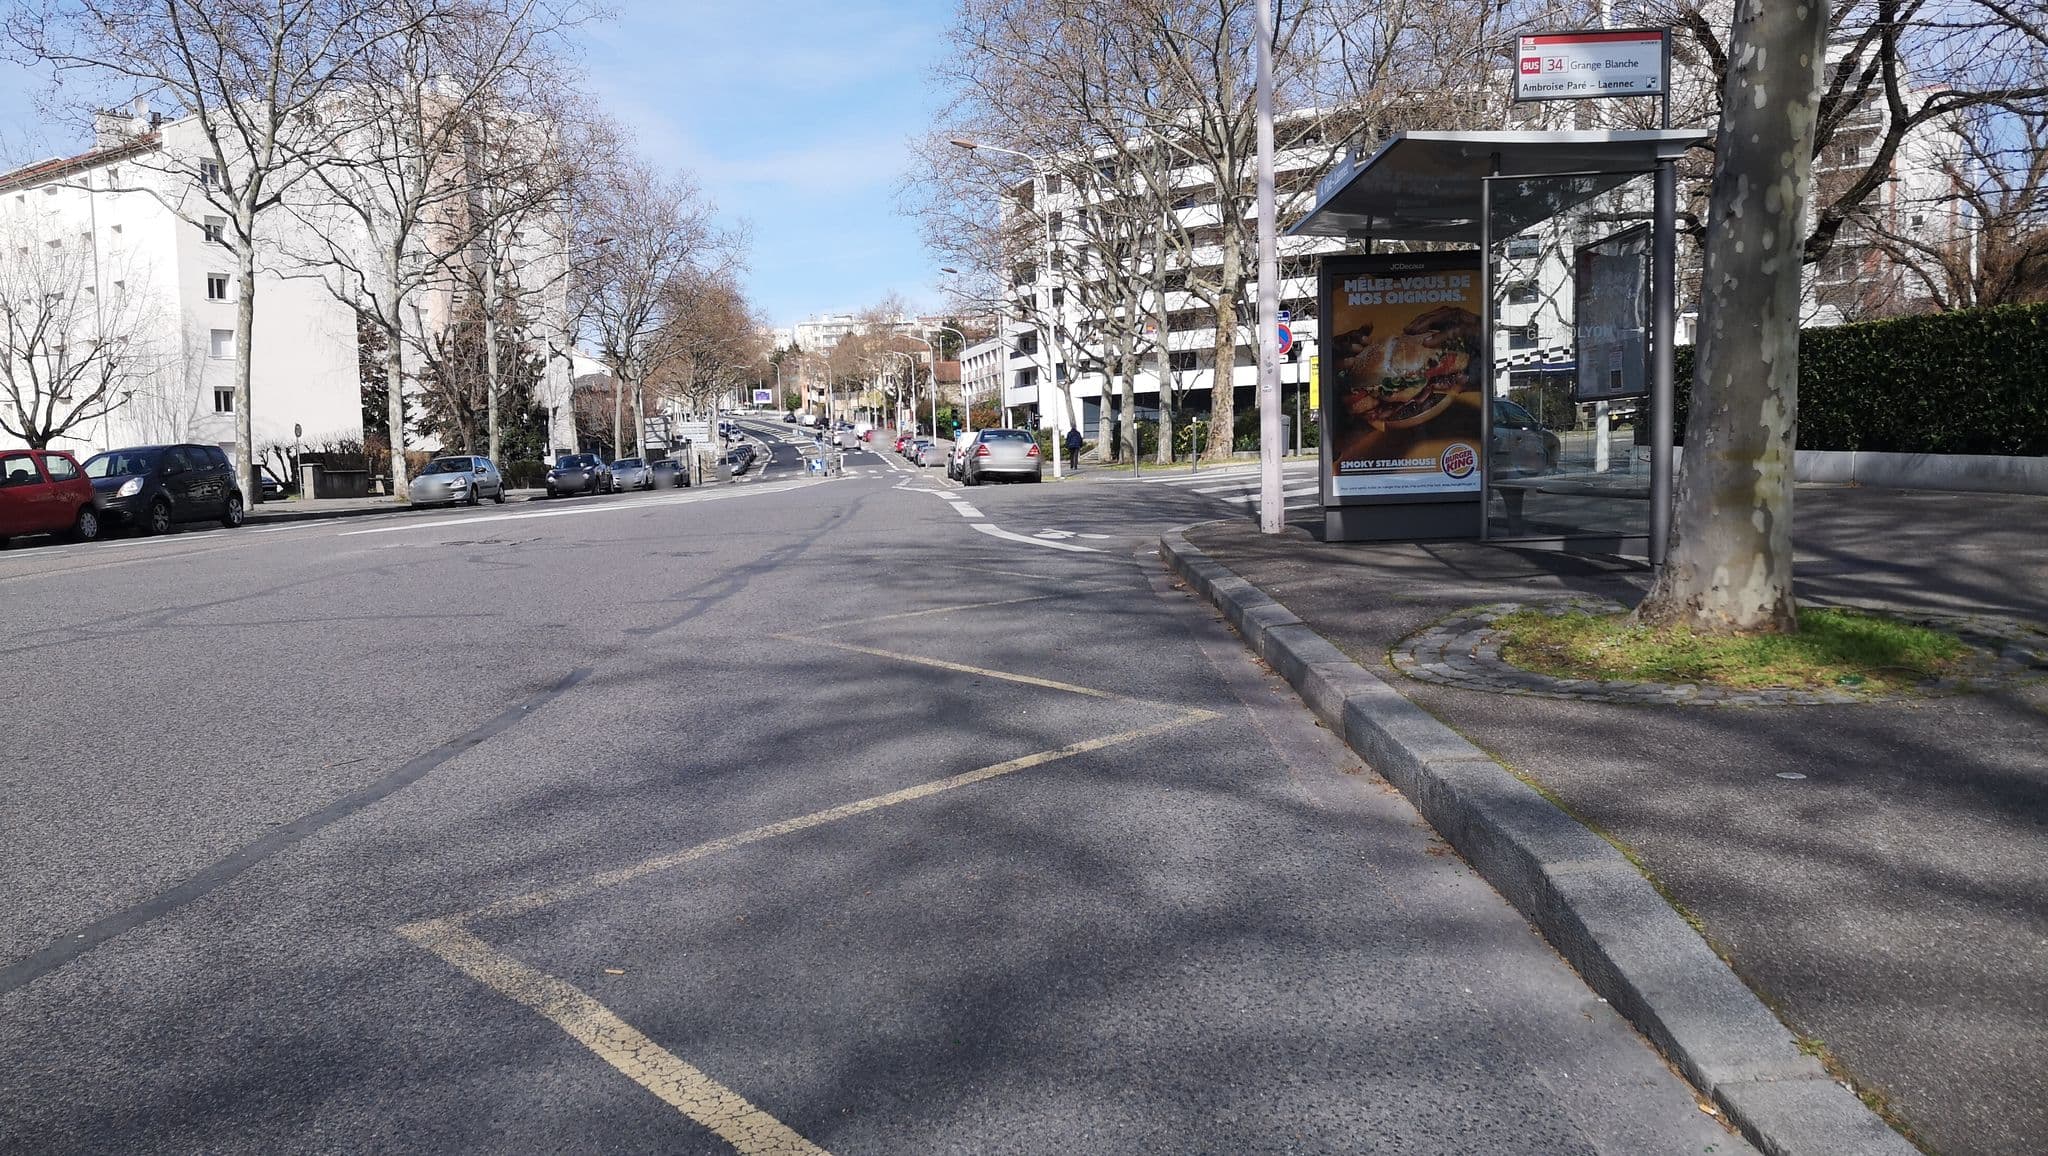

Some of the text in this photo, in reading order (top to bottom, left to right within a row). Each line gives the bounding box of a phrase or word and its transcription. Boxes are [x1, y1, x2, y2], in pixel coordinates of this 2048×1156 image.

[1523, 58, 1639, 72] BUS 34 Grange Blanche
[1522, 82, 1564, 92] Ambroise
[1567, 81, 1587, 91] Paré
[1598, 79, 1635, 89] Laennec
[1344, 275, 1470, 292] MÊLEZ-VOUS DE
[1348, 289, 1466, 305] NOS OIGNONS.
[1340, 458, 1437, 469] SMOKY STEAKHOUSE
[1444, 449, 1473, 464] BURGER
[1445, 457, 1474, 472] KING
